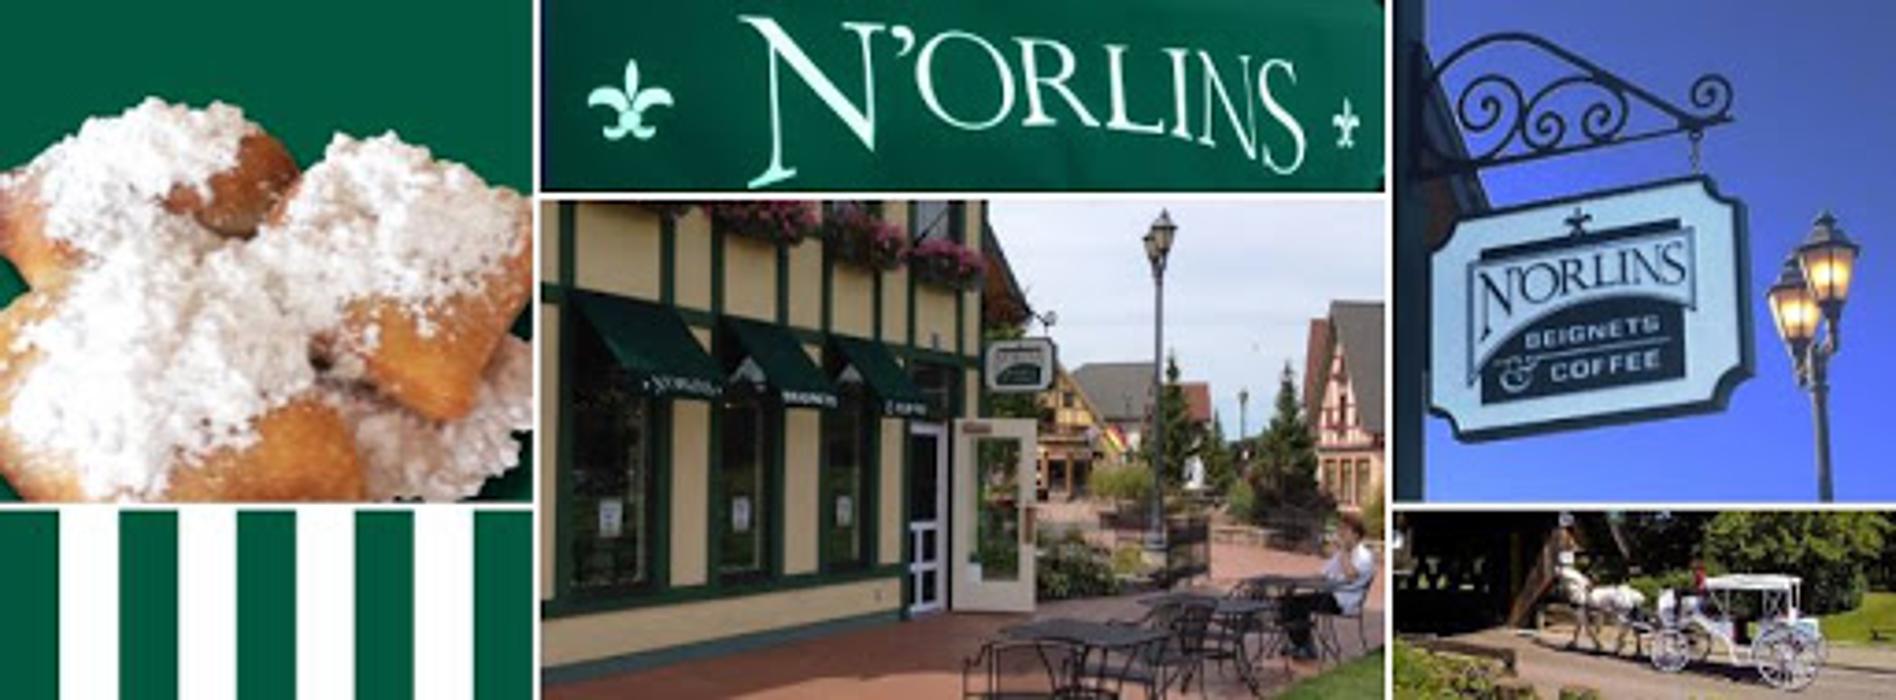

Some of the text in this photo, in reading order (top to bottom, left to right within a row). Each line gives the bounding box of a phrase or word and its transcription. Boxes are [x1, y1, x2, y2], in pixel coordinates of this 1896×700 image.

[738, 14, 1306, 188] N'ORLINS
[1525, 314, 1660, 349] BEIGNETS
[1493, 351, 1661, 393] & COFFEE
